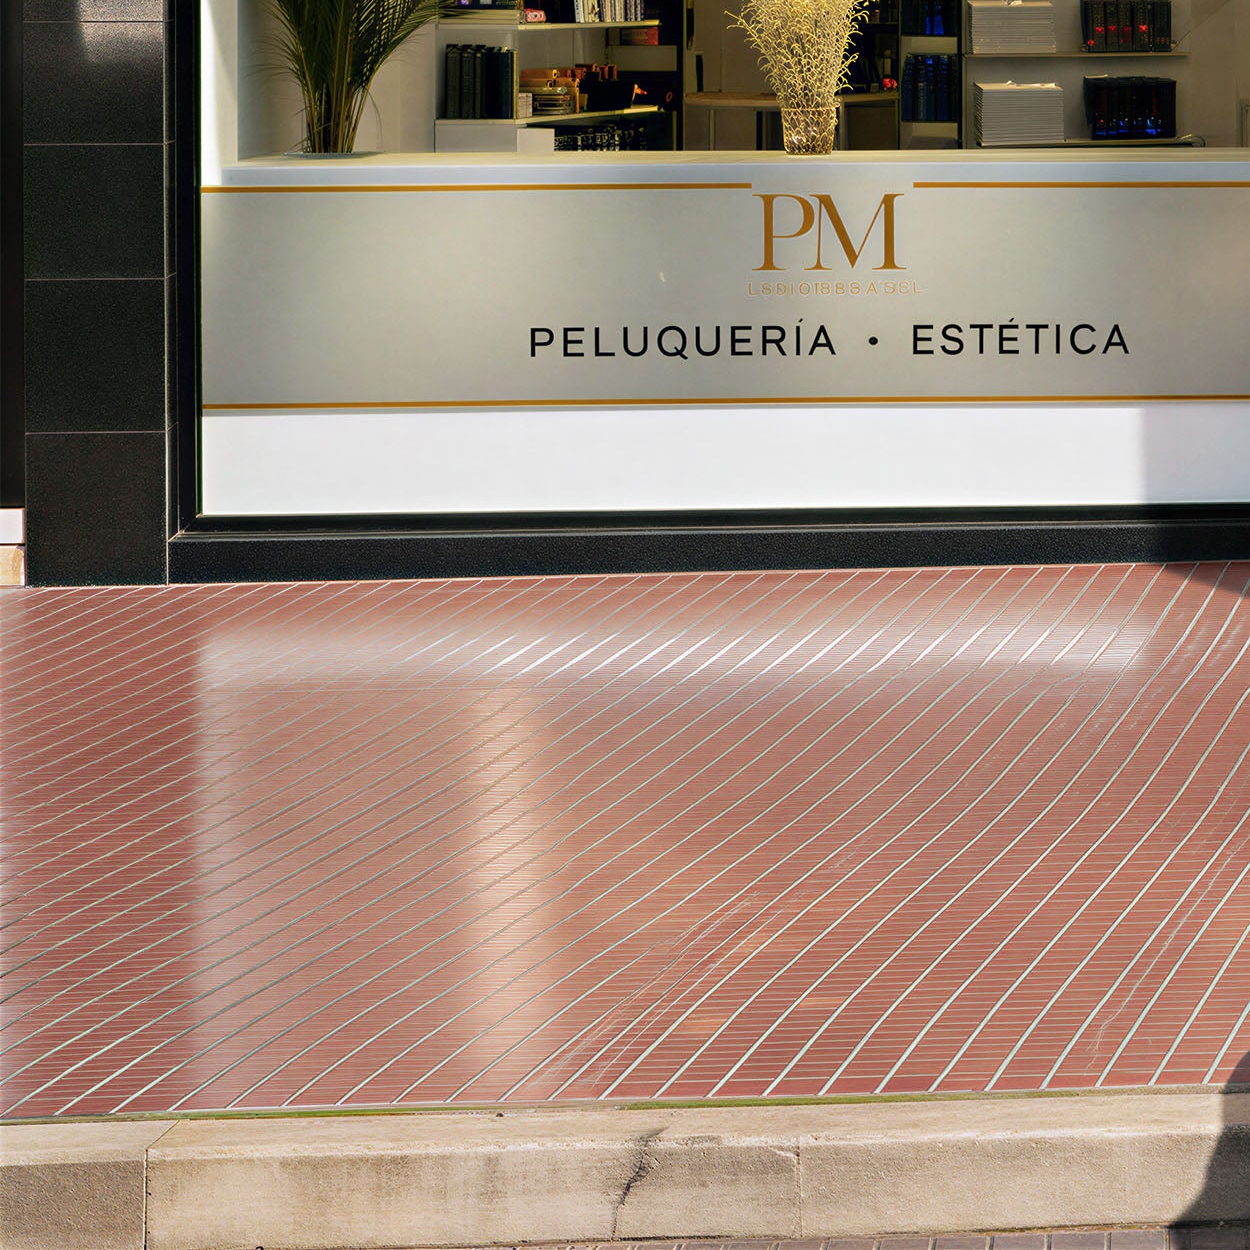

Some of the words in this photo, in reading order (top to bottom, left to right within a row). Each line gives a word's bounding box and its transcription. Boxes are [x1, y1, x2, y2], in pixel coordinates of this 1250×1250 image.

[751, 193, 907, 271] PM
[530, 319, 837, 361] PELUQUERÍA
[912, 317, 1131, 356] ESTÉTICA
